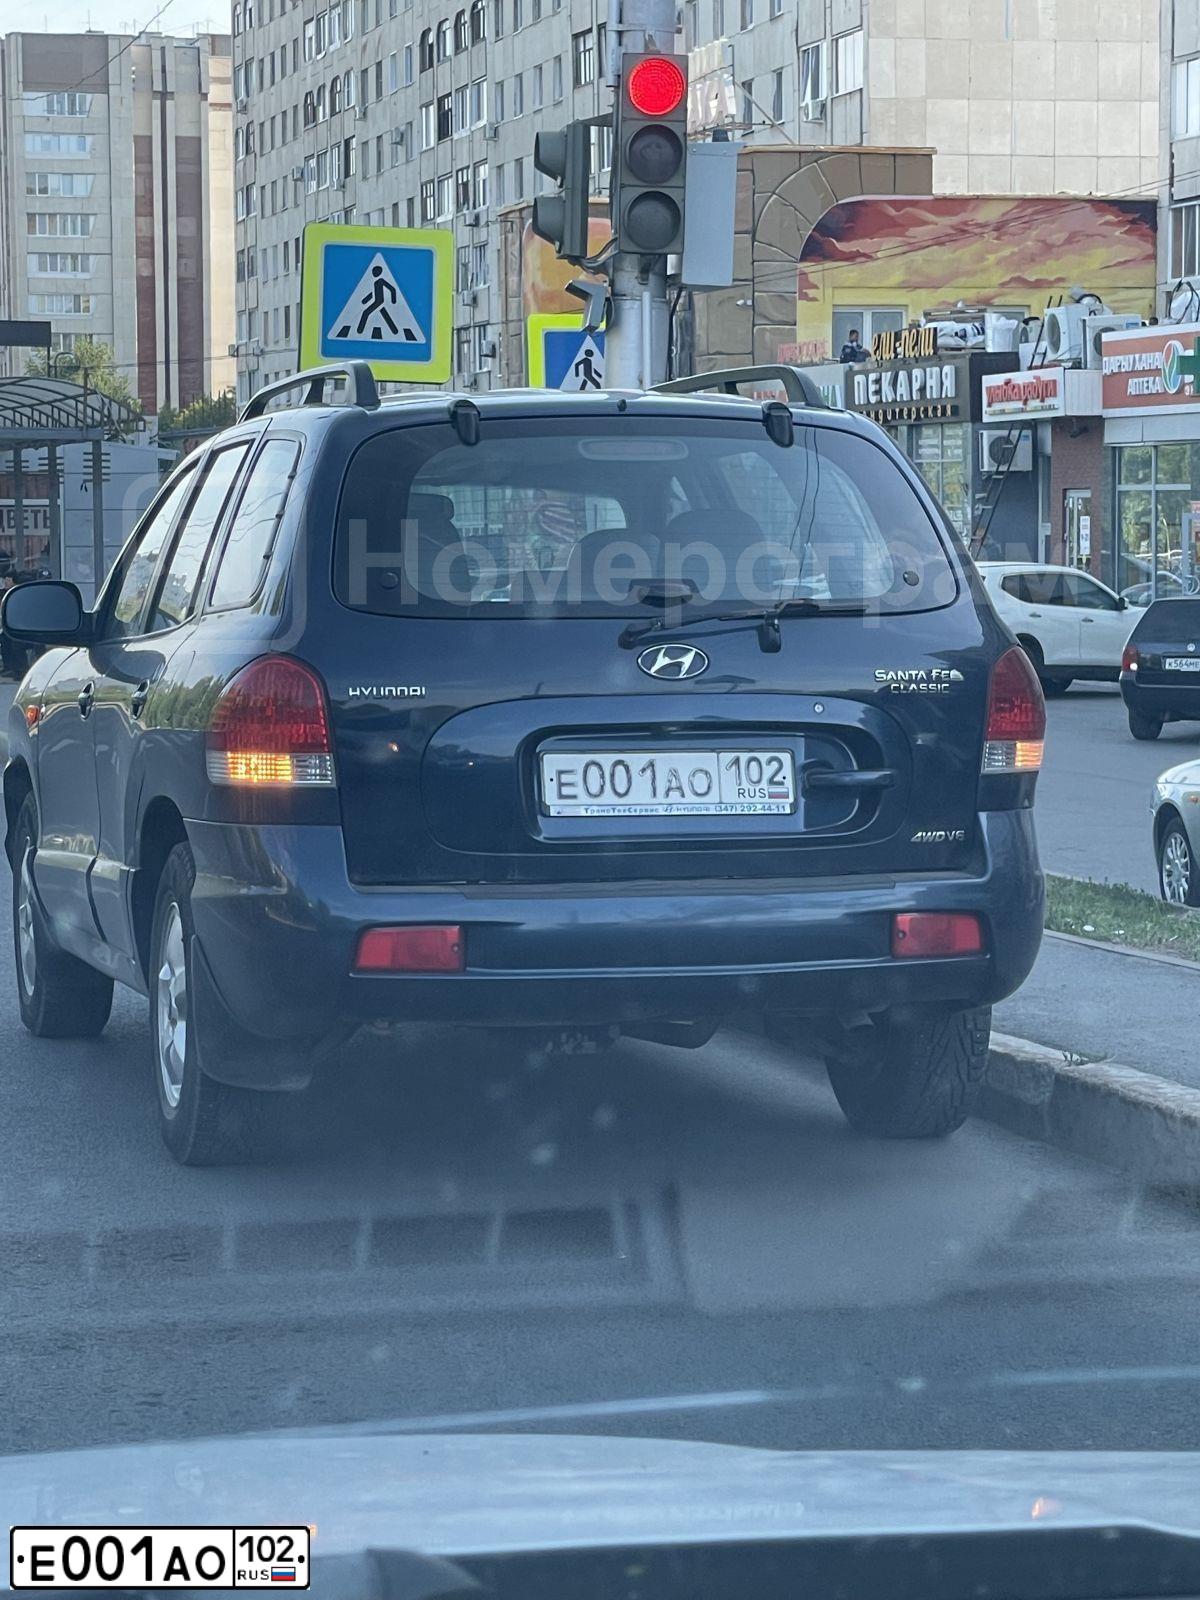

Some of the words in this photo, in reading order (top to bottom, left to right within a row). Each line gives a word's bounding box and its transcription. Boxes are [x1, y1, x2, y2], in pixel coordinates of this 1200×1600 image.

[854, 365, 956, 405] ПЕКАРНЯ
[1127, 376, 1165, 396] АПТЕКА
[862, 404, 952, 424] ндитерская
[874, 669, 927, 681] SANTA
[348, 686, 426, 697] HYUNDAI
[890, 683, 950, 694] CLASSIC
[555, 758, 713, 799] Е001АО
[725, 755, 785, 786] 102
[738, 788, 766, 799] RUS
[715, 804, 737, 813] (347)
[740, 803, 786, 813] 292-44-11
